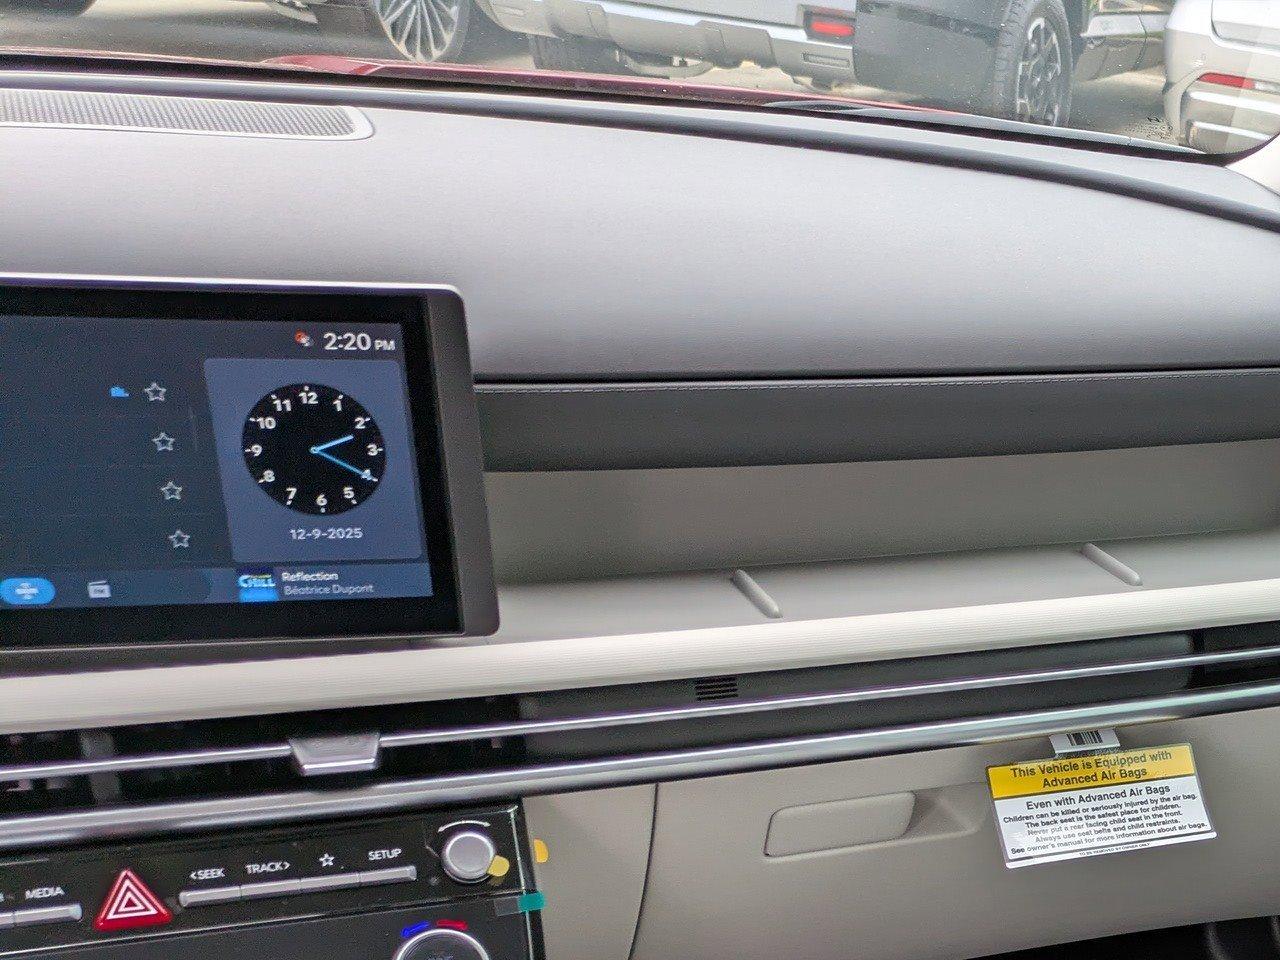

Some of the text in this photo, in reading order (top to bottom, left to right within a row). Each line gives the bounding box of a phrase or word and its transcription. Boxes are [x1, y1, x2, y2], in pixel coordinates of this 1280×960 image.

[323, 332, 396, 351] 2:20 PM
[299, 392, 318, 404] 12
[272, 399, 292, 412] 11
[333, 400, 342, 412] 1
[256, 417, 277, 430] 10
[354, 417, 366, 429] 2
[251, 444, 263, 457] 9
[366, 444, 378, 456] 3
[262, 469, 276, 483] 8
[361, 469, 372, 481] 4
[285, 487, 298, 500] 7
[343, 487, 355, 499] 5
[316, 493, 328, 507] 6
[290, 527, 364, 540] 12-9-2025
[281, 571, 339, 582] Reflection
[331, 583, 374, 597] Dupont
[1010, 751, 1172, 778] This Vehicle is Equipped with
[1042, 768, 1148, 788] Advanced Air Bags
[1026, 785, 1171, 811] Even with Advanced Air Bags
[1003, 813, 1034, 824] Children
[1061, 807, 1080, 816] killed
[1091, 802, 1123, 812] seriously
[1125, 799, 1149, 809] injured
[1150, 797, 1159, 806] by
[1160, 795, 1171, 803] the
[1182, 793, 1197, 801] bag.
[1041, 818, 1058, 827] back
[1060, 816, 1075, 824] seat
[1097, 810, 1119, 819] safest
[1120, 808, 1139, 817] place
[1140, 805, 1150, 813] for
[1151, 802, 1182, 812] children.
[1027, 828, 1049, 836] Never
[1050, 827, 1063, 835] put
[1085, 820, 1108, 829] facing
[1109, 816, 1126, 824] child
[1152, 811, 1163, 819] the
[1164, 809, 1183, 817] front.
[1035, 834, 1061, 843] Always
[1094, 827, 1111, 836] belts
[1112, 824, 1126, 832] and
[1127, 821, 1145, 830] child
[1146, 818, 1181, 828] restraints.
[1011, 847, 1026, 855] See
[1027, 843, 1056, 852] owner's
[1057, 839, 1084, 848] manual
[1116, 829, 1156, 840] information
[1157, 825, 1177, 833] about
[1188, 821, 1207, 830] bags.
[367, 848, 402, 861] SETUP
[25, 887, 66, 900] MEDIA
